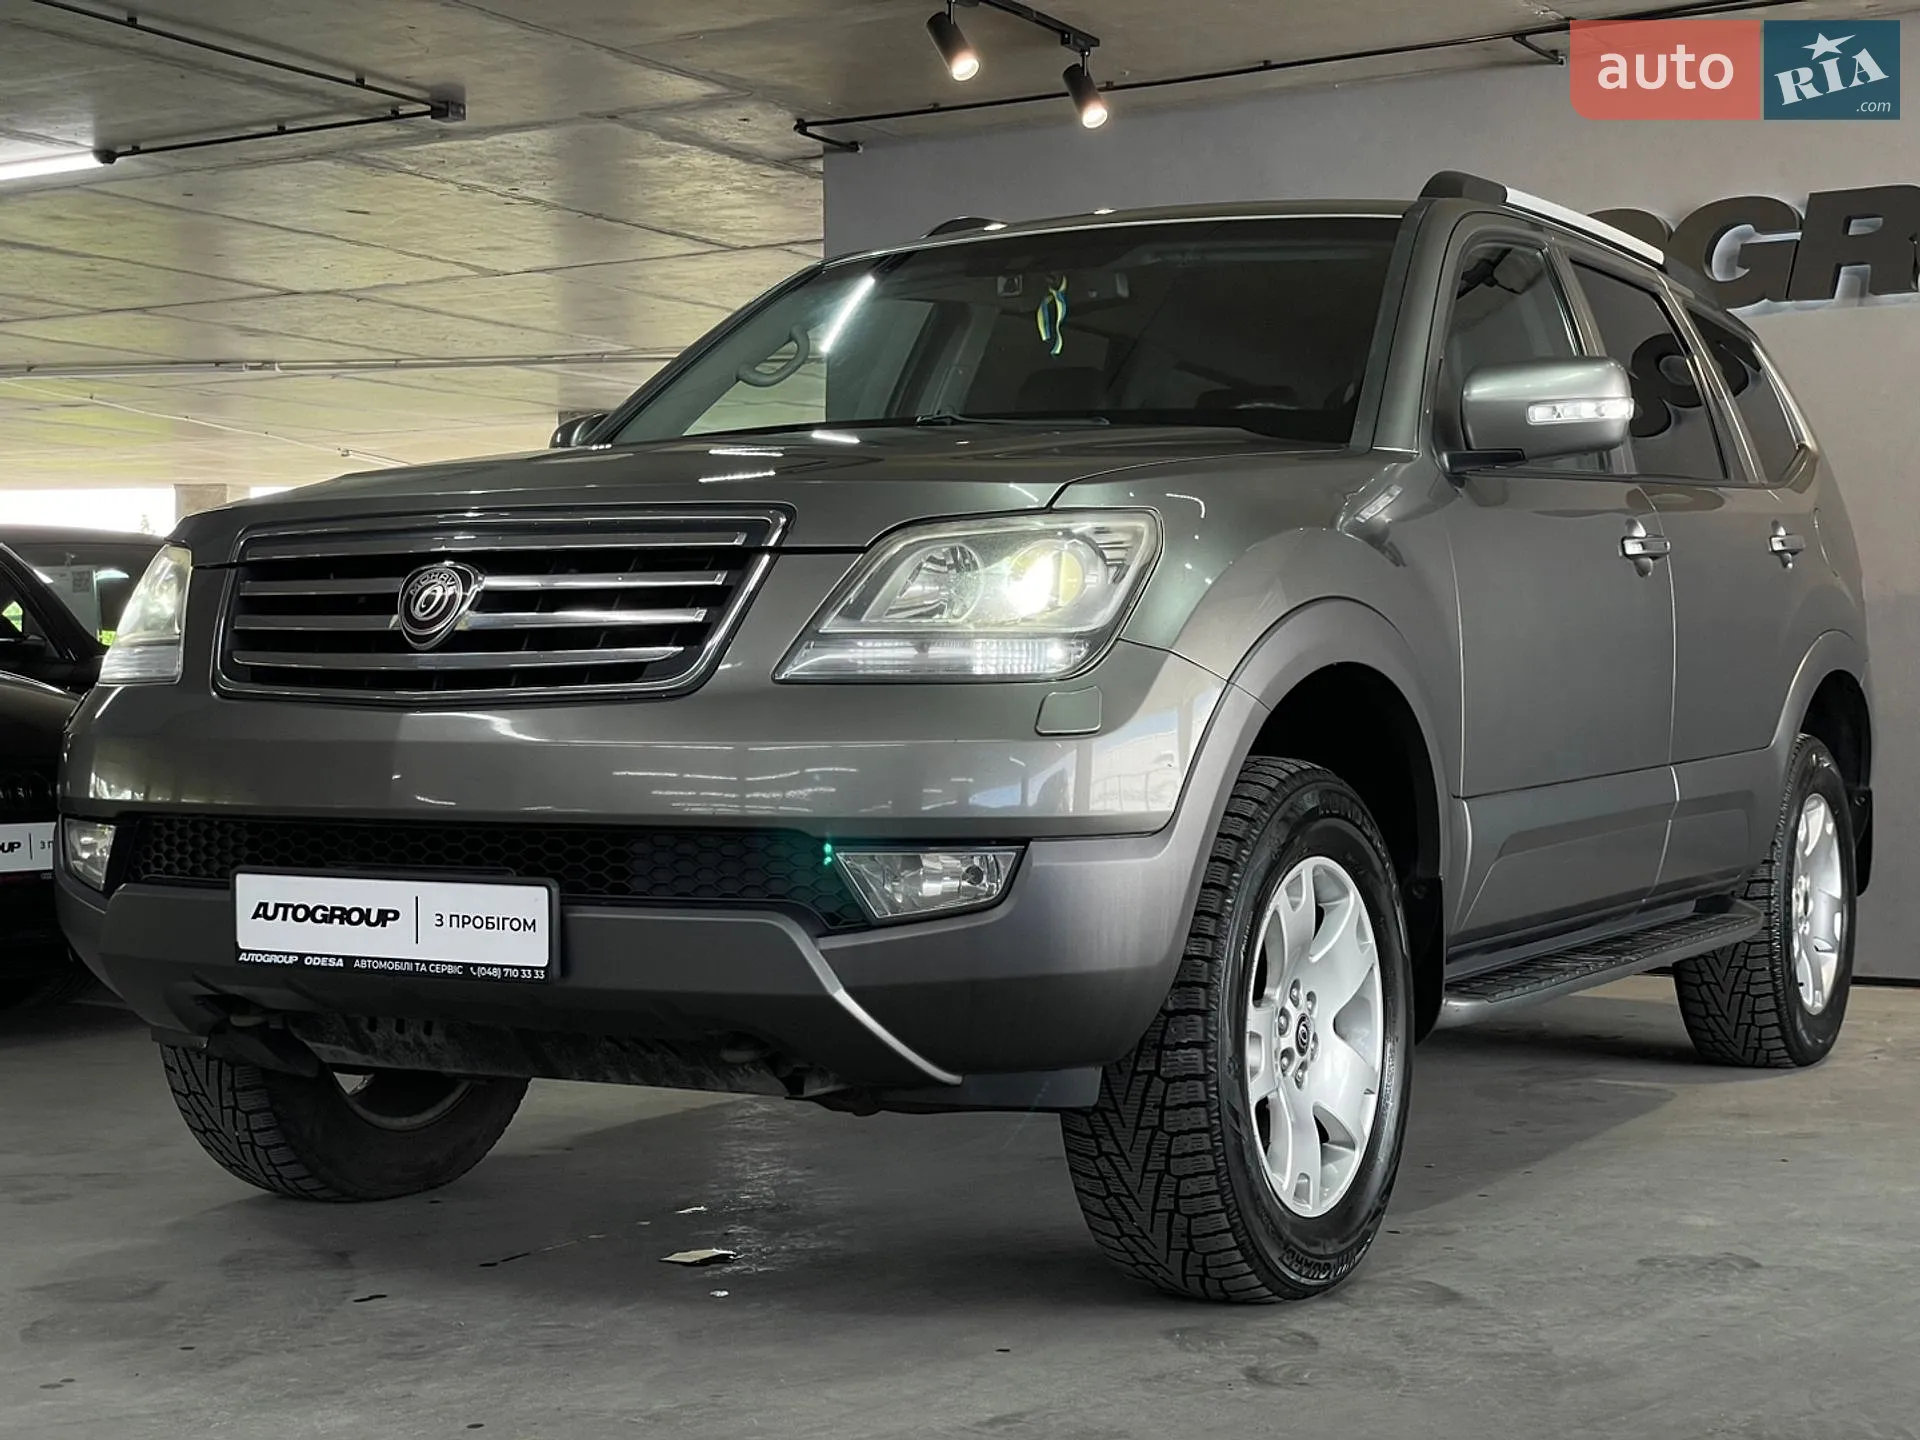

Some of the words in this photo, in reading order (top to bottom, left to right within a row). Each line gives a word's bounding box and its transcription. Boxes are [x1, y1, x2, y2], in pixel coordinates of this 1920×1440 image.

[251, 901, 400, 928] AUTOGROUP
[449, 914, 537, 932] ПРОБІГОМ
[238, 952, 299, 965] AUTOGROUP
[304, 956, 344, 968] ODESA
[353, 959, 413, 972] АВТОМОБІЛІ
[415, 962, 428, 973] ТА
[428, 963, 464, 975] СЕРВІС
[477, 966, 502, 979] (048)
[503, 967, 519, 978] 710
[520, 969, 533, 979] 33
[533, 969, 545, 980] 33
